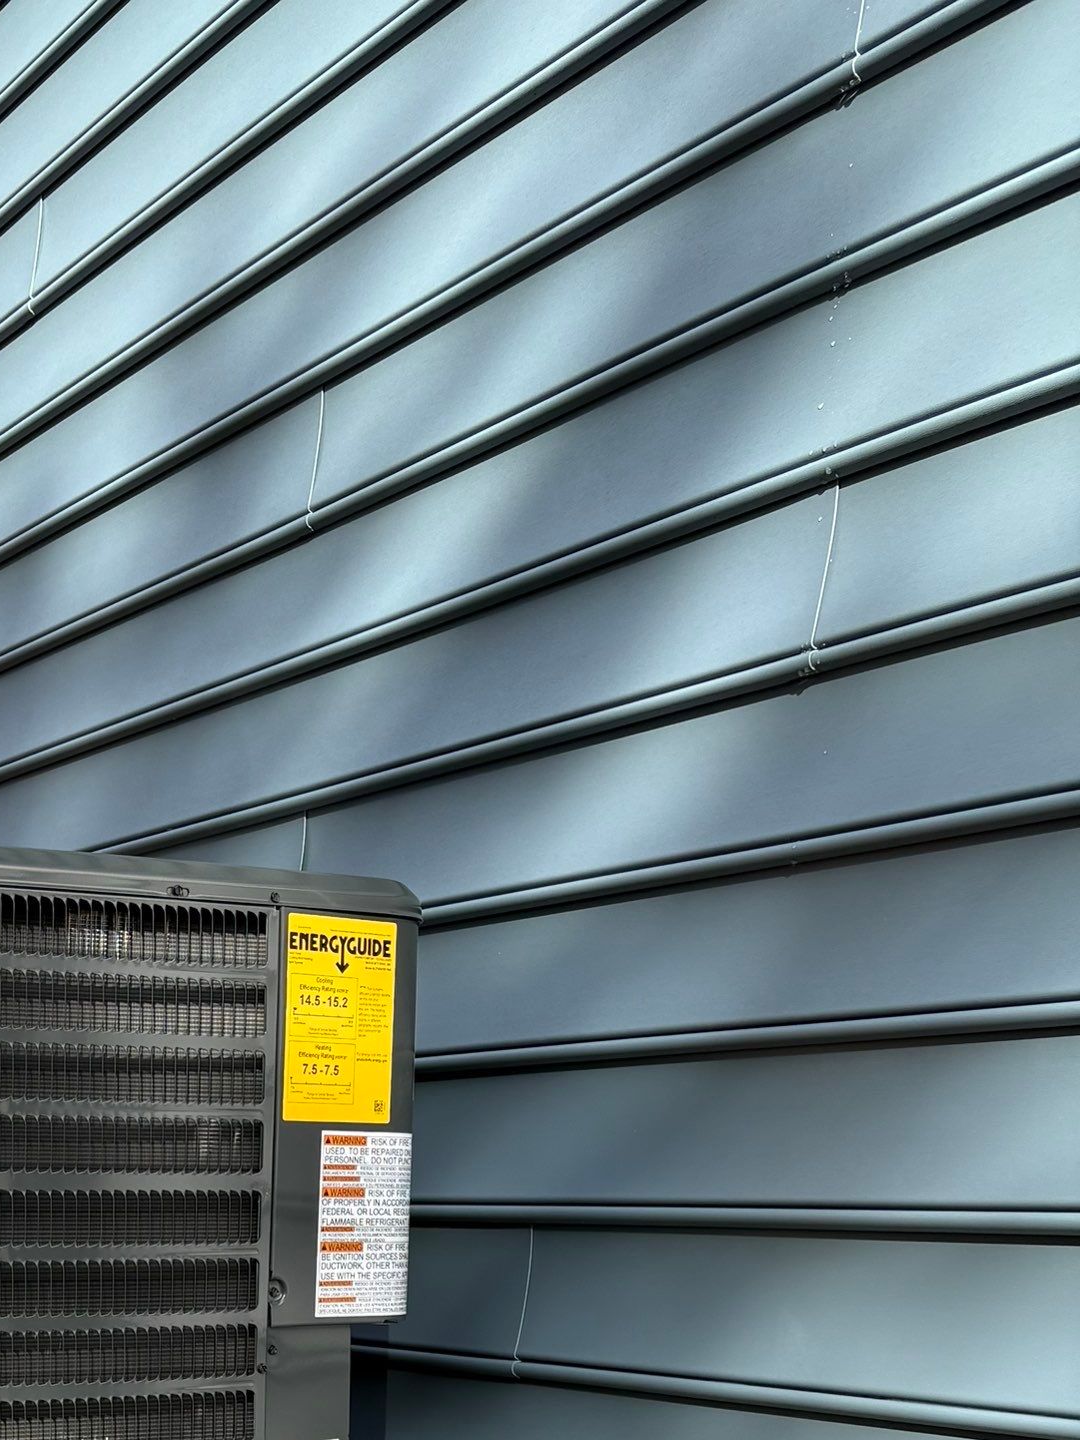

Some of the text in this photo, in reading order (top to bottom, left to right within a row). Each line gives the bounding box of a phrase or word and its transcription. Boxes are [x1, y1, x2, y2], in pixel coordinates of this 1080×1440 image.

[289, 932, 392, 958] ENERGYGUIDE
[300, 984, 320, 992] Efficiency
[298, 1052, 320, 1060] Efficiency
[332, 1136, 367, 1146] WARNING
[371, 1138, 388, 1146] RISK
[371, 1148, 403, 1156] REPAIRED
[330, 1188, 365, 1197] WARNING
[334, 1199, 371, 1207] PROPERLY
[322, 1218, 364, 1226] FLAMMABLE
[328, 1242, 363, 1251] WARNING
